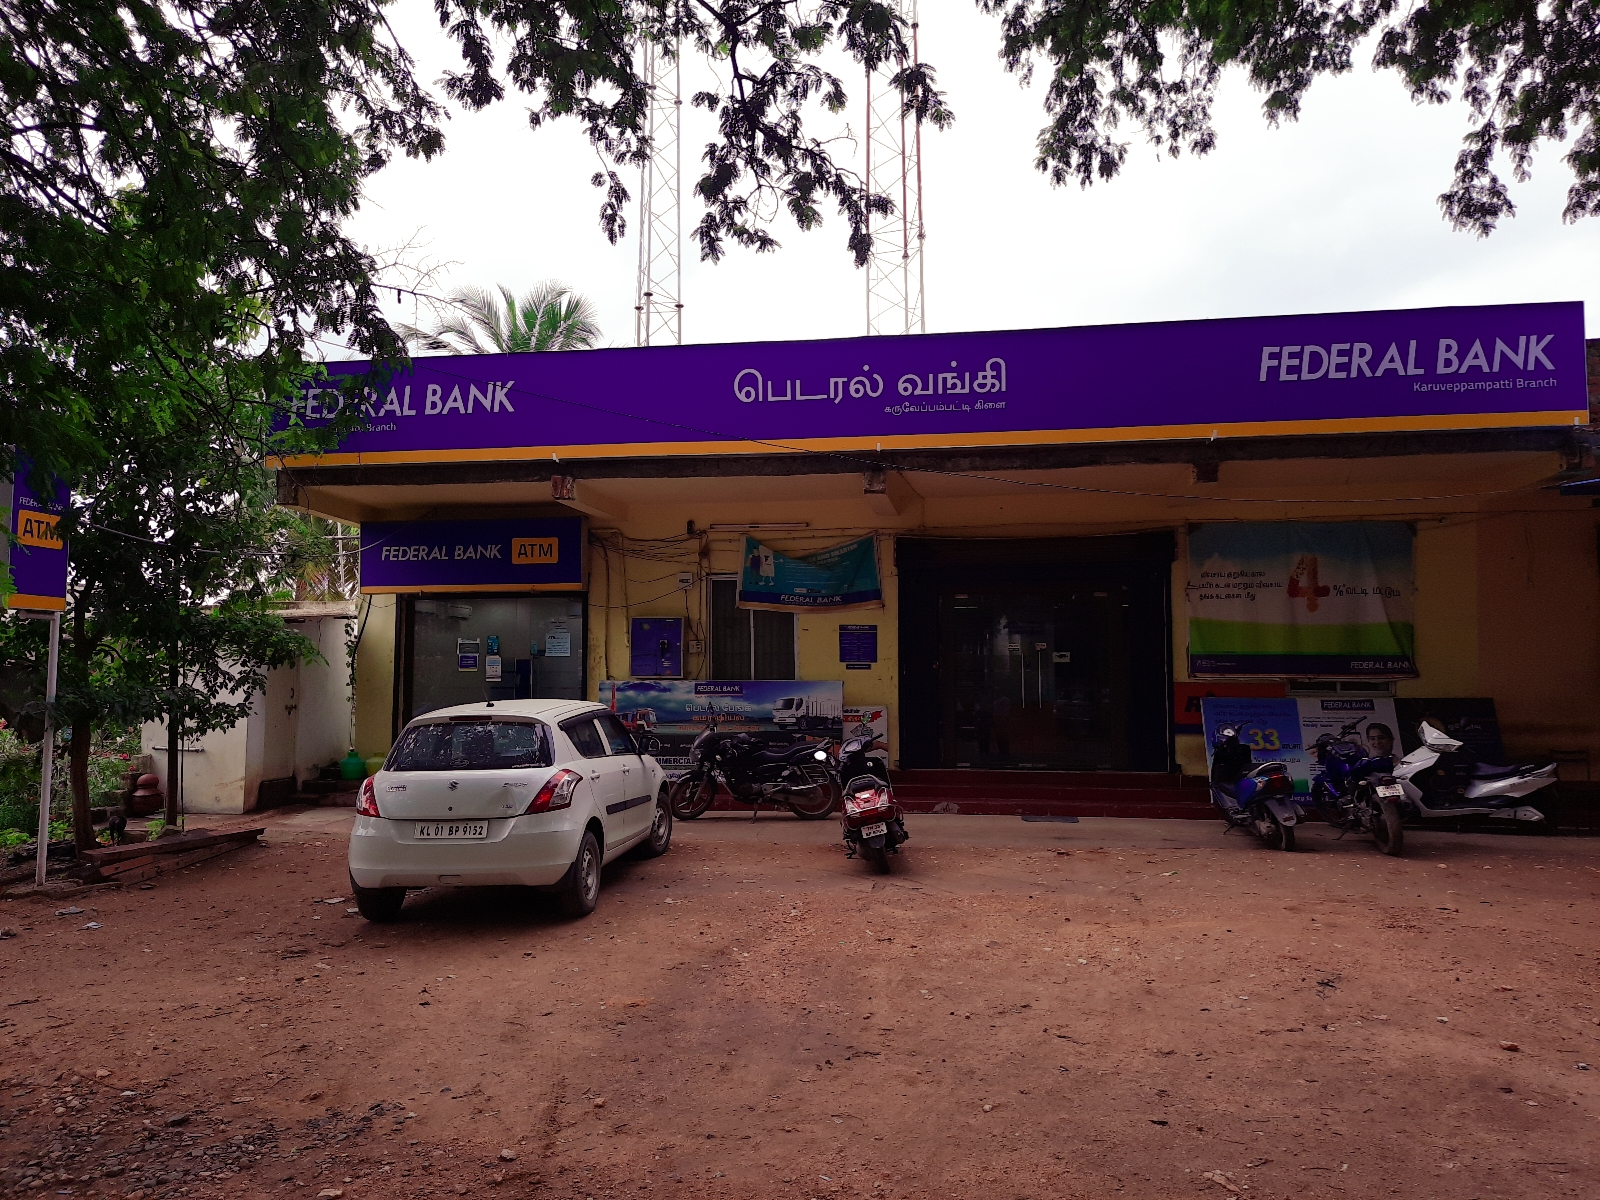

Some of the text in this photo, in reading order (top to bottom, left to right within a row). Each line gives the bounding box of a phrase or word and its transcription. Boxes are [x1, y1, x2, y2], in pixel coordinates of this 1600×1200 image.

[1259, 334, 1555, 382] FEDERAL BANK
[733, 357, 1006, 404] பெடரல் வங்கி
[1413, 377, 1557, 392] Karuveppampatti Branch
[424, 381, 515, 415] BANK
[974, 399, 1006, 411] கிளை
[23, 517, 60, 541] ATM
[381, 544, 502, 561] FEDERAL BANK
[517, 543, 553, 558] ATM
[1287, 554, 1330, 613] 4
[781, 594, 842, 603] FEDERAL BANK
[1350, 661, 1384, 669] FEDERAL
[1248, 728, 1280, 751] 33
[420, 825, 431, 837] KL
[435, 825, 443, 836] 01
[448, 825, 460, 836] BP
